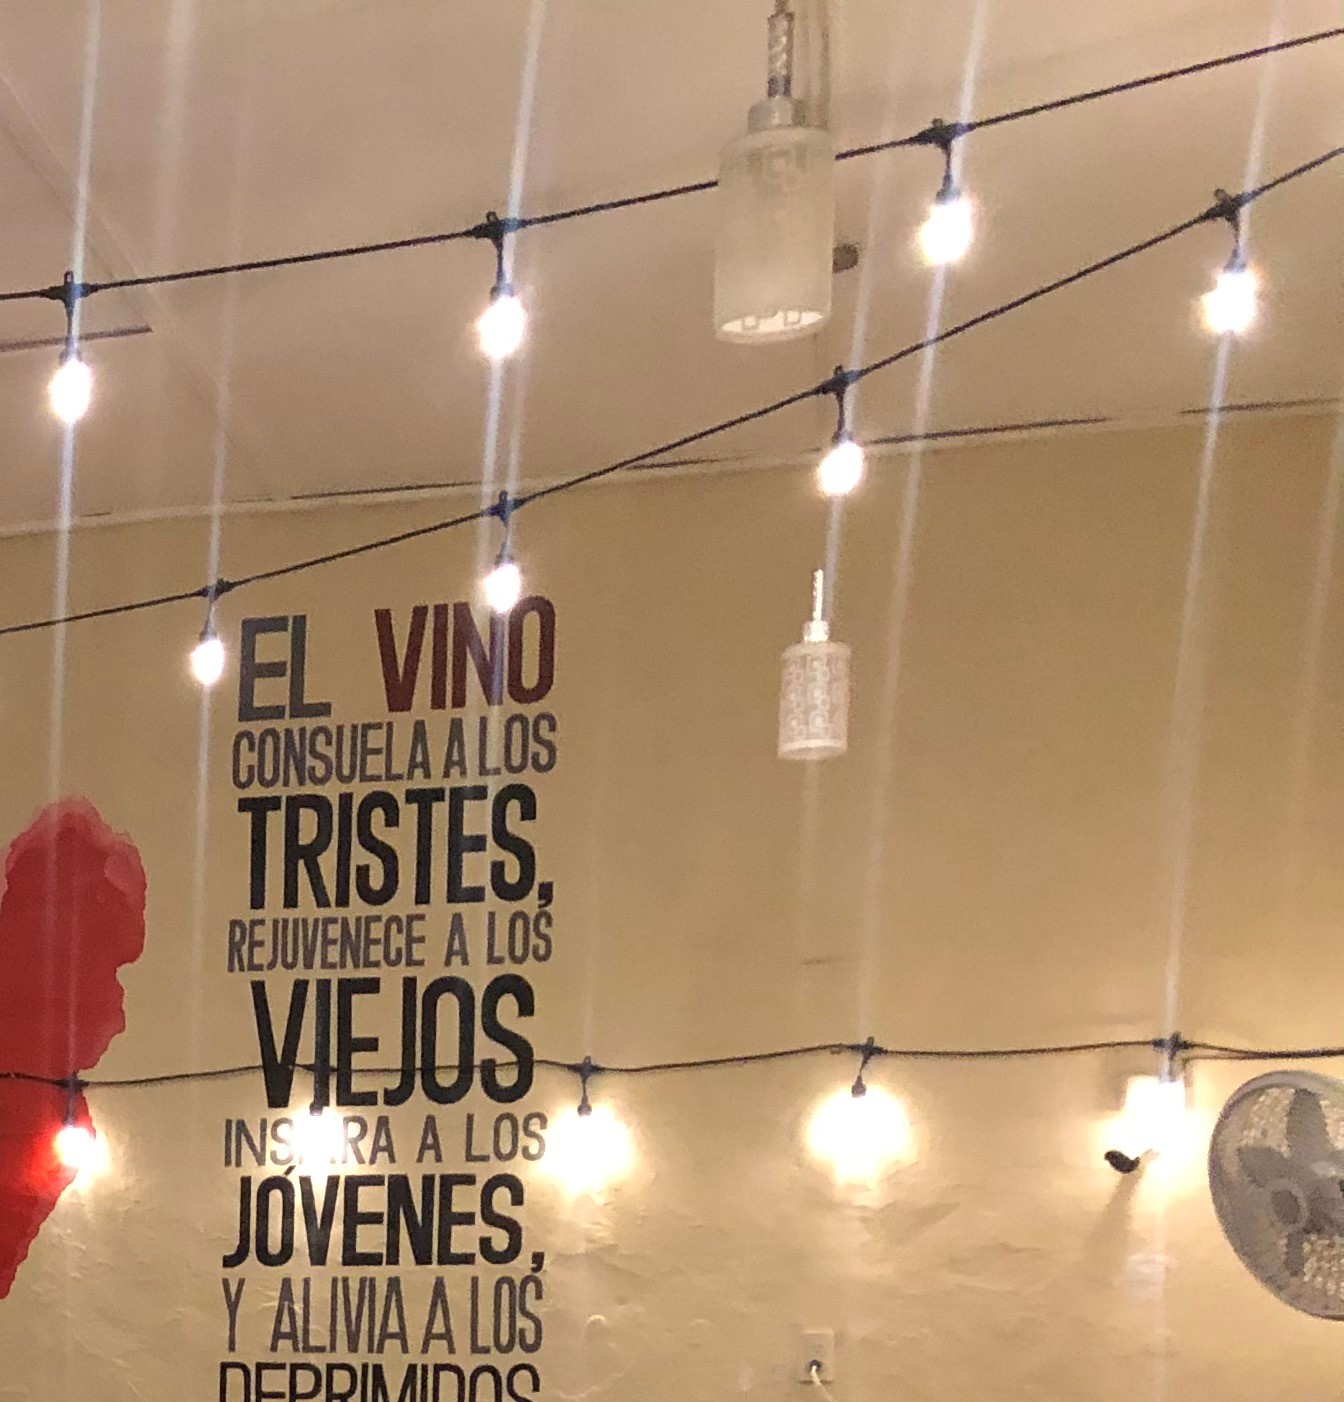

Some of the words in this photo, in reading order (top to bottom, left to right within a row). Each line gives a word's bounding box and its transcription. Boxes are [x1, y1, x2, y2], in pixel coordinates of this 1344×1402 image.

[238, 613, 332, 722] EL
[374, 595, 556, 713] VINO
[232, 718, 431, 790] CONSUELA
[443, 717, 467, 778] A
[479, 712, 558, 776] LOS
[238, 783, 554, 909] TRISTES,
[227, 913, 425, 973] REJUVENECE
[444, 913, 470, 967] A
[487, 909, 554, 966] LOS
[250, 973, 536, 1108] VIEJOS
[224, 1114, 396, 1167] INSRA
[417, 1114, 442, 1163] A
[466, 1112, 549, 1163] LOS
[222, 1165, 545, 1272] JÓVENES,
[222, 1276, 246, 1353] Y
[270, 1276, 409, 1355] ALIVIA
[421, 1276, 456, 1355] A
[471, 1275, 544, 1355] LOS
